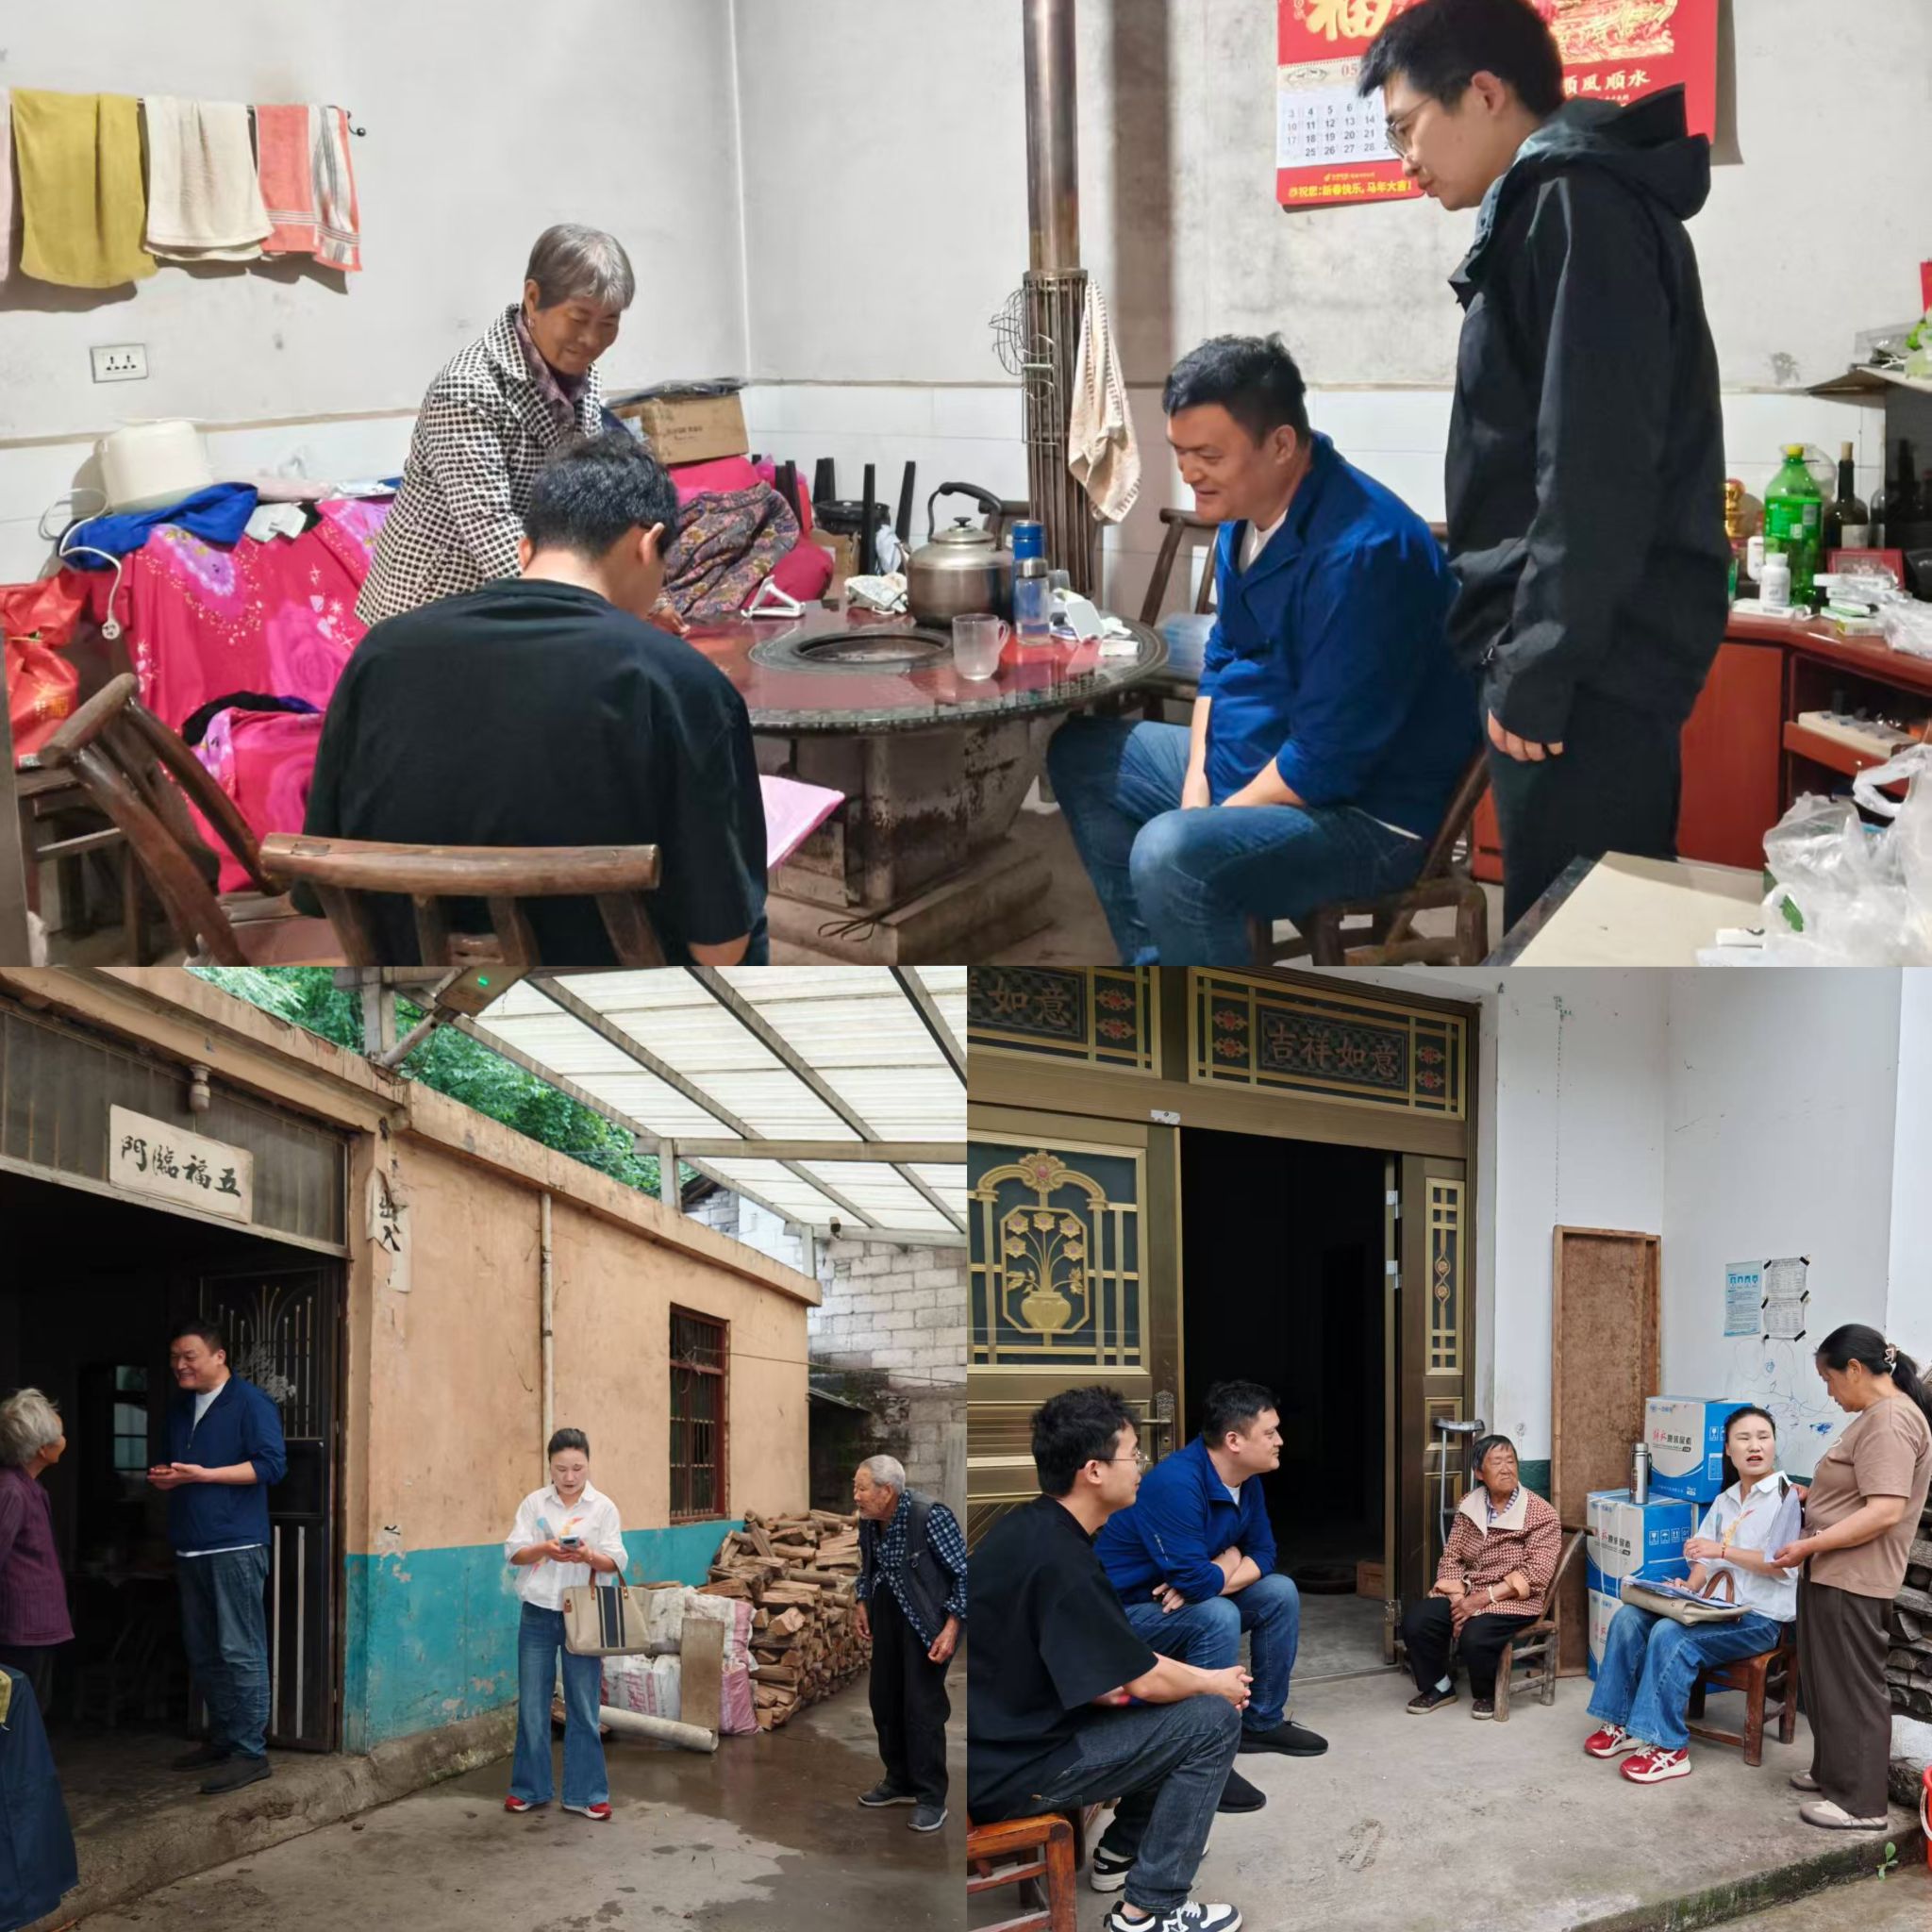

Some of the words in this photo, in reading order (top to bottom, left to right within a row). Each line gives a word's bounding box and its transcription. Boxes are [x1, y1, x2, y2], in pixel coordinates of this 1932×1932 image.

[1341, 64, 1358, 76] 05
[1307, 108, 1314, 116] 4
[1327, 105, 1333, 114] 5
[1346, 104, 1353, 112] 6
[1367, 101, 1373, 109] 7
[1288, 123, 1297, 131] 10
[1325, 119, 1336, 127] 12
[1345, 117, 1356, 125] 13
[1365, 115, 1375, 124] 14
[1288, 136, 1297, 144] 17
[1306, 135, 1316, 143] 18
[1324, 133, 1336, 142] 19
[1344, 131, 1356, 140] 20
[1364, 129, 1374, 138] 21
[1306, 148, 1316, 157] 25
[1324, 146, 1336, 155] 26
[1344, 144, 1355, 153] 27
[1364, 142, 1375, 151] 28
[1269, 1023, 1399, 1077] 吉祥如意
